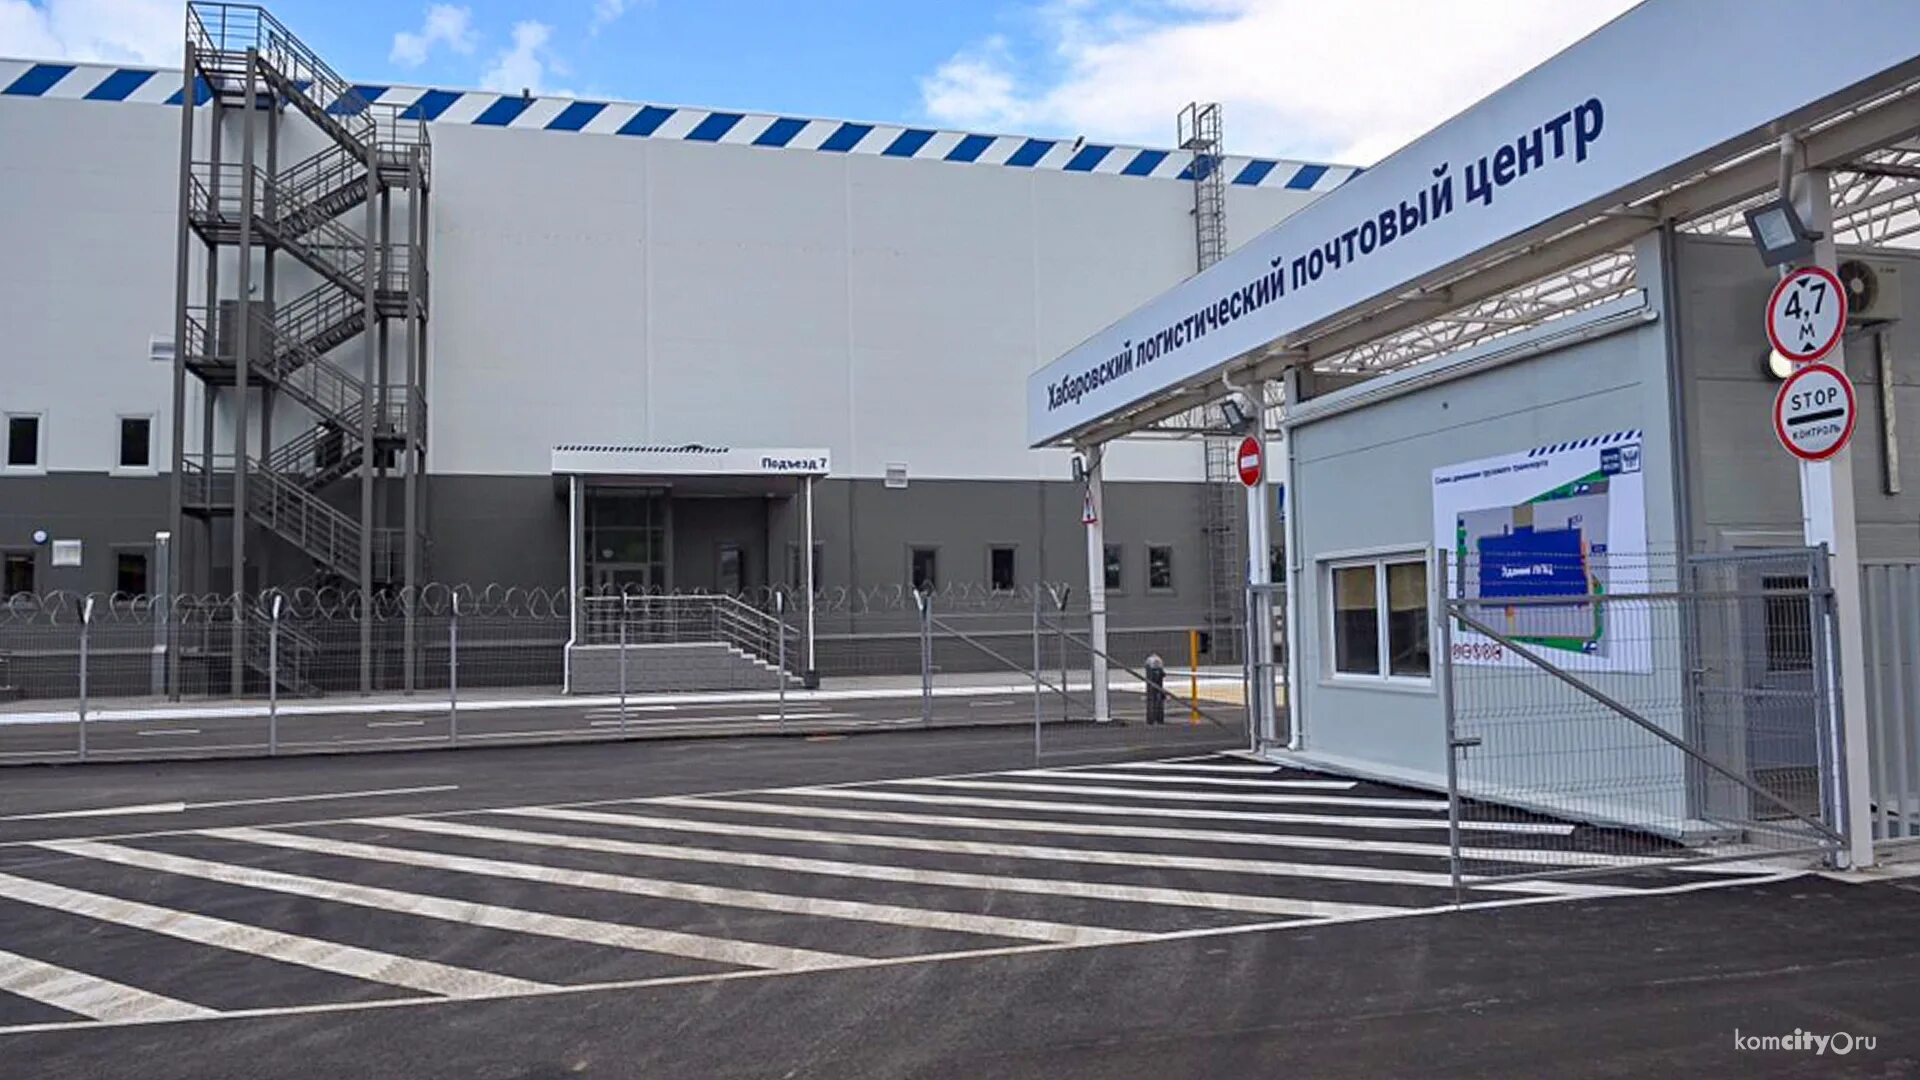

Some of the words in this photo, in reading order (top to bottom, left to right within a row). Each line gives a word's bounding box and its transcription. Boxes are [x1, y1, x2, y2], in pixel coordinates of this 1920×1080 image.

[1047, 341, 1134, 411] Хабаровский
[1136, 261, 1285, 367] логистический
[1291, 164, 1454, 288] почтовый
[1465, 96, 1605, 207] центр
[1784, 282, 1826, 322] 4,7
[1791, 387, 1838, 411] STOP
[762, 457, 817, 471] Подъезд
[819, 457, 827, 468] 7
